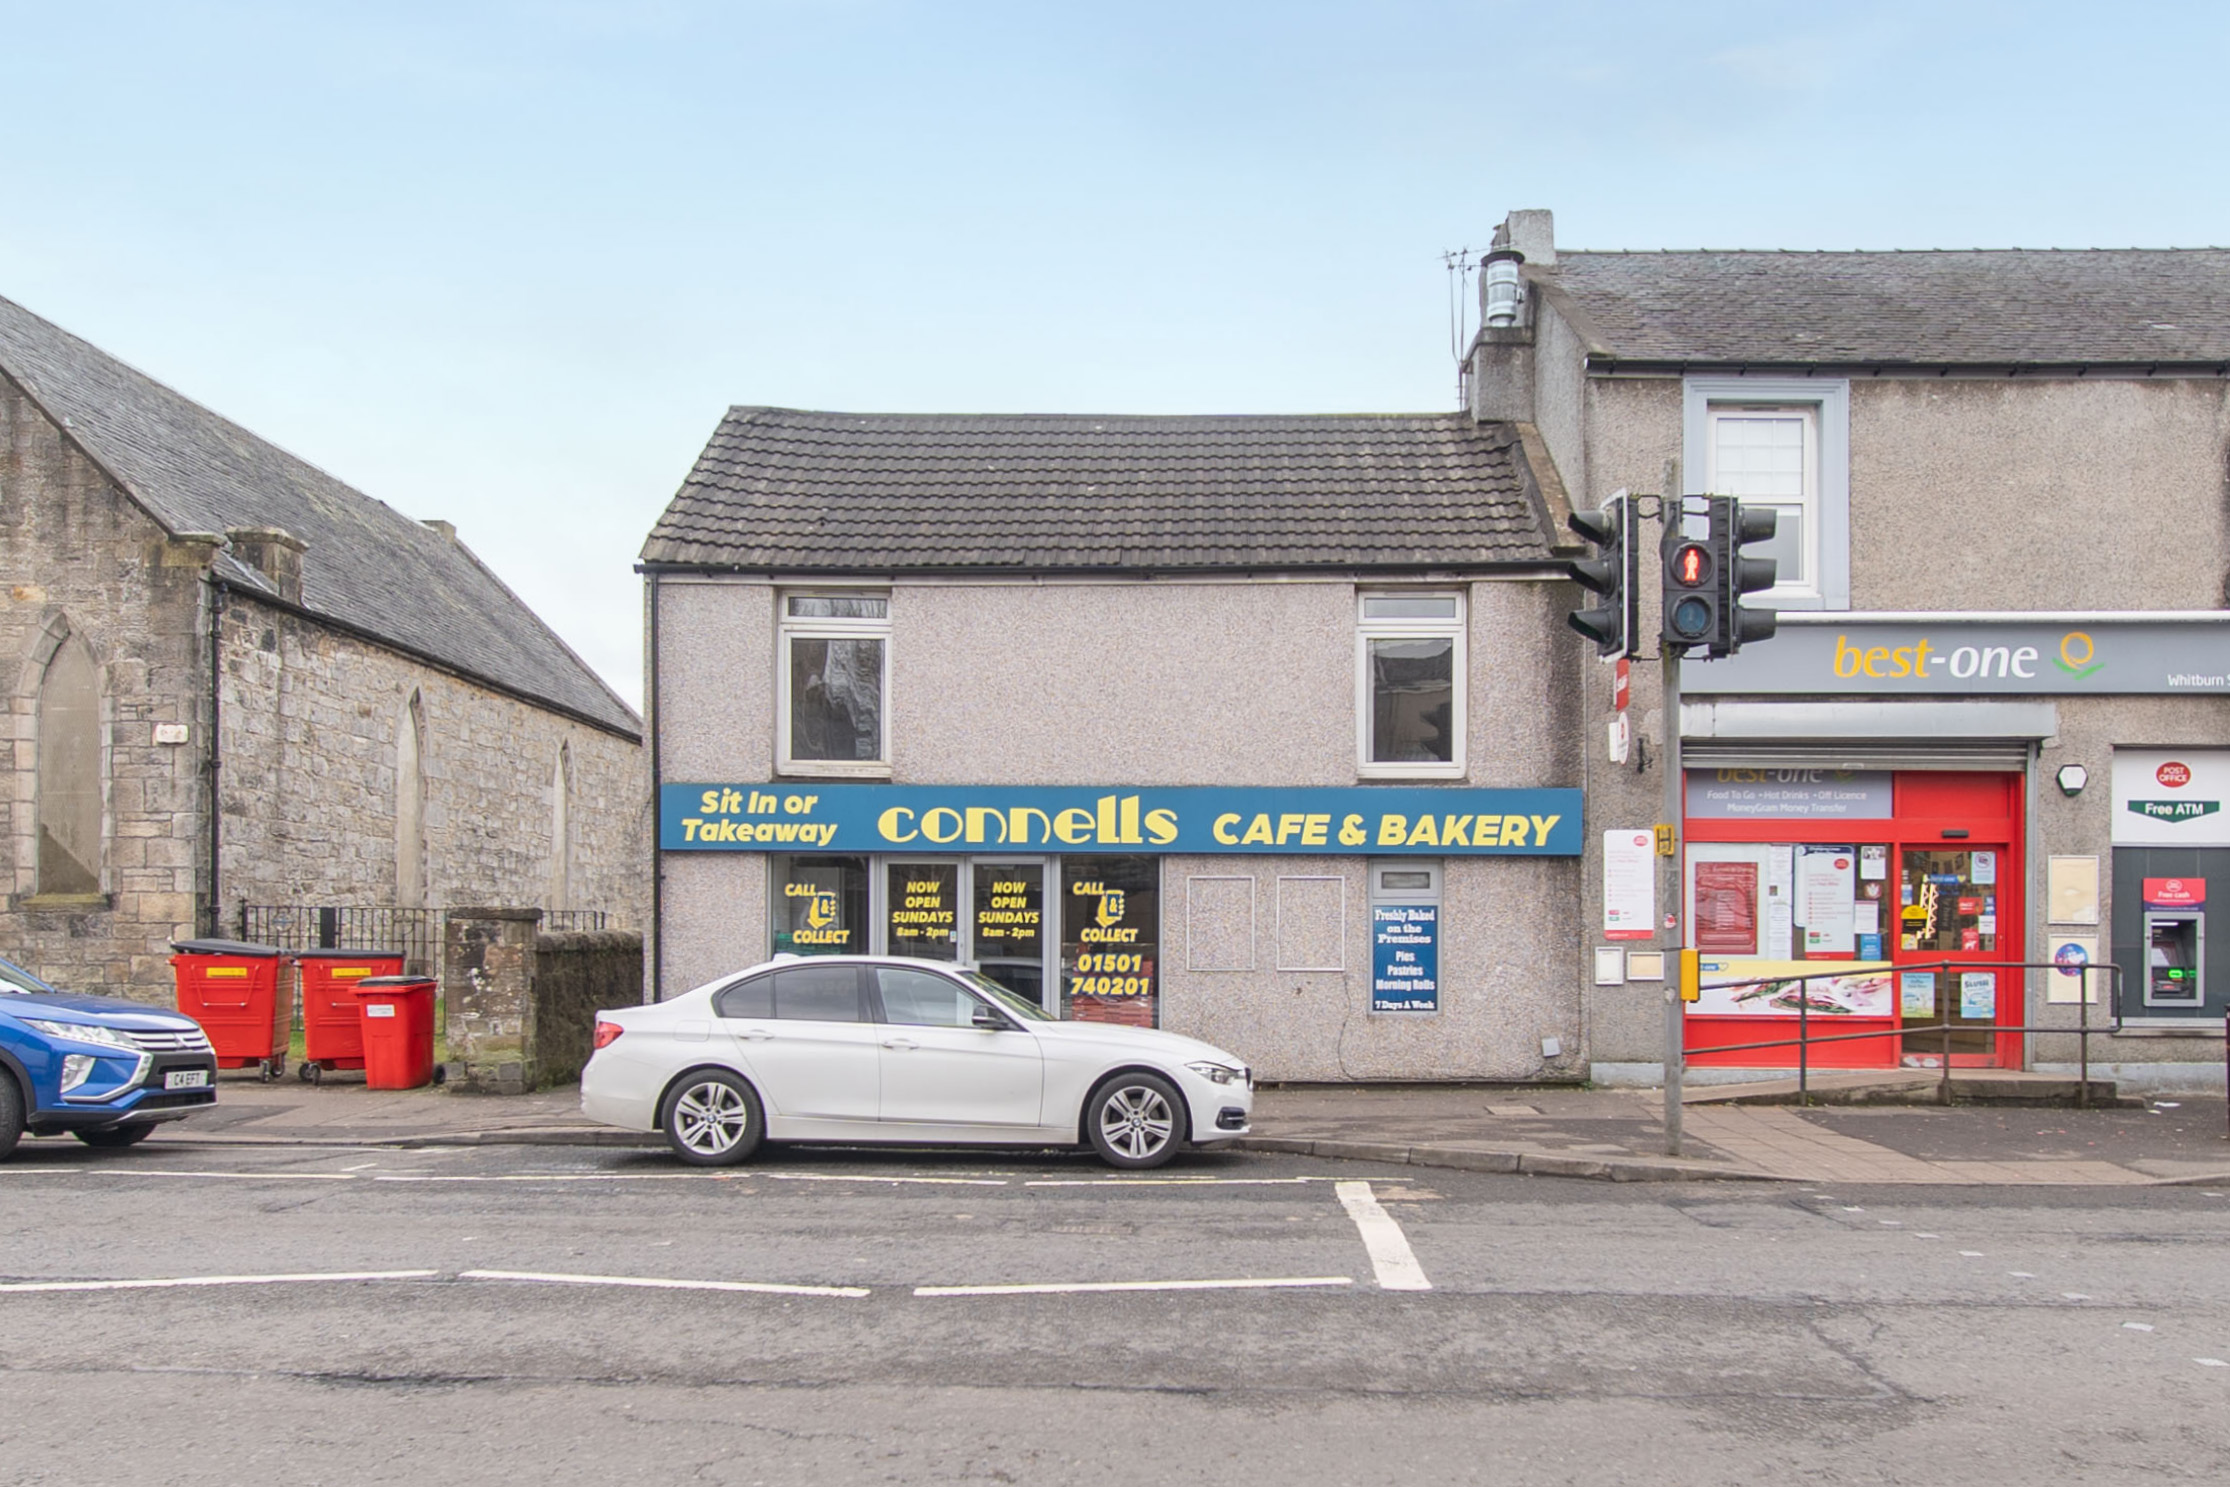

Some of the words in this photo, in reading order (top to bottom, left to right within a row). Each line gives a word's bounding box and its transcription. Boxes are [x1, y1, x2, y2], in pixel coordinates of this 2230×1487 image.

[1833, 635, 2038, 678] best-one
[2167, 674, 2224, 687] Whitburn
[2159, 774, 2187, 782] OFFICE
[700, 787, 743, 814] Sit
[747, 791, 778, 814] In
[784, 795, 818, 814] or
[1707, 790, 1729, 800] Food
[1782, 790, 1809, 800] Drinks
[1833, 790, 1867, 800] Licence
[1727, 804, 1778, 814] MoneyGram
[1780, 804, 1809, 814] Money
[1811, 804, 1847, 814] Transfer
[2145, 803, 2173, 815] Free
[2175, 803, 2203, 815] ATM
[877, 795, 1178, 844] connells
[682, 818, 838, 847] Takeaway
[1213, 813, 1331, 846] CAFE
[1338, 814, 1367, 846] &
[1377, 815, 1561, 846] BAKERY
[784, 884, 816, 897] CALL
[906, 882, 940, 893] NOW
[992, 882, 1026, 893] NOW
[1073, 882, 1105, 895] CALL
[820, 899, 830, 915] &
[905, 897, 941, 908] OPEN
[991, 897, 1027, 909] OPEN
[1109, 898, 1117, 913] &
[892, 912, 954, 923] SUNDAYS
[978, 912, 1039, 924] SUNDAYS
[1375, 909, 1407, 922] Freshly
[1408, 909, 1435, 921] Baked
[896, 927, 918, 937] 8am
[926, 927, 949, 939] 2pm
[982, 927, 1004, 938] 8am
[1011, 927, 1035, 940] 2pm
[1387, 925, 1401, 933] on
[1403, 923, 1422, 933] the
[792, 930, 849, 944] COLLECT
[1080, 928, 1138, 942] COLLECT
[1378, 934, 1431, 944] Premises
[1395, 951, 1415, 962] Pies
[1077, 954, 1142, 973] 01501
[1387, 965, 1423, 976] Pastries
[1070, 977, 1149, 996] 740201
[1375, 979, 1412, 991] Morning
[1413, 979, 1435, 990] Rolls
[1382, 1001, 1402, 1010] Days
[1403, 1001, 1411, 1009] A
[1412, 1001, 1435, 1009] Week
